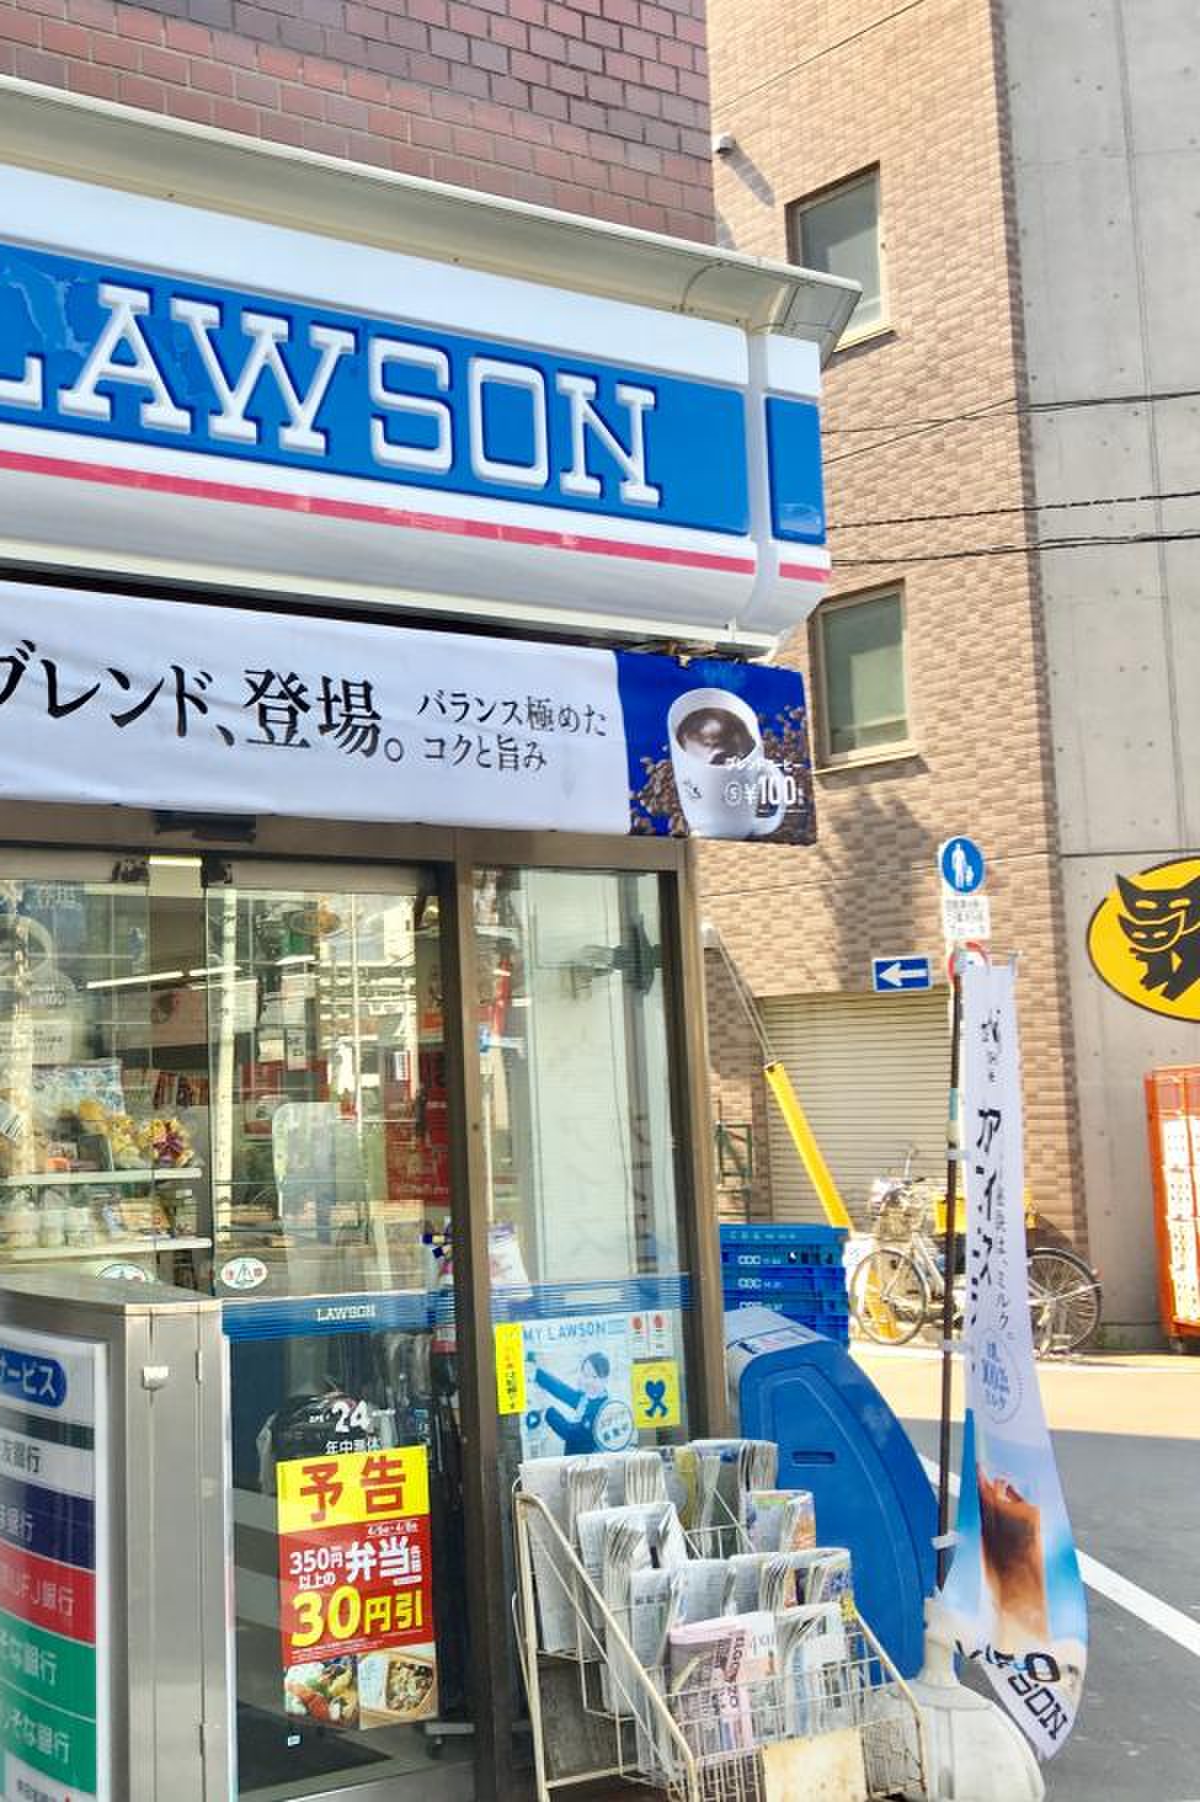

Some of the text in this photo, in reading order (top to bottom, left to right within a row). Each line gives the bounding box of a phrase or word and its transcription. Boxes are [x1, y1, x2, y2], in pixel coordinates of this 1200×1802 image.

[416, 689, 607, 737] バランス極めた
[423, 734, 547, 772] コクと旨み
[317, 1304, 376, 1322] LAWSON
[332, 1400, 371, 1433] 24
[300, 1453, 407, 1523] 予告
[289, 1545, 344, 1575] 350円
[346, 1536, 409, 1583] 弁当
[299, 1571, 336, 1590] 以上の
[291, 1584, 423, 1647] 30円引
